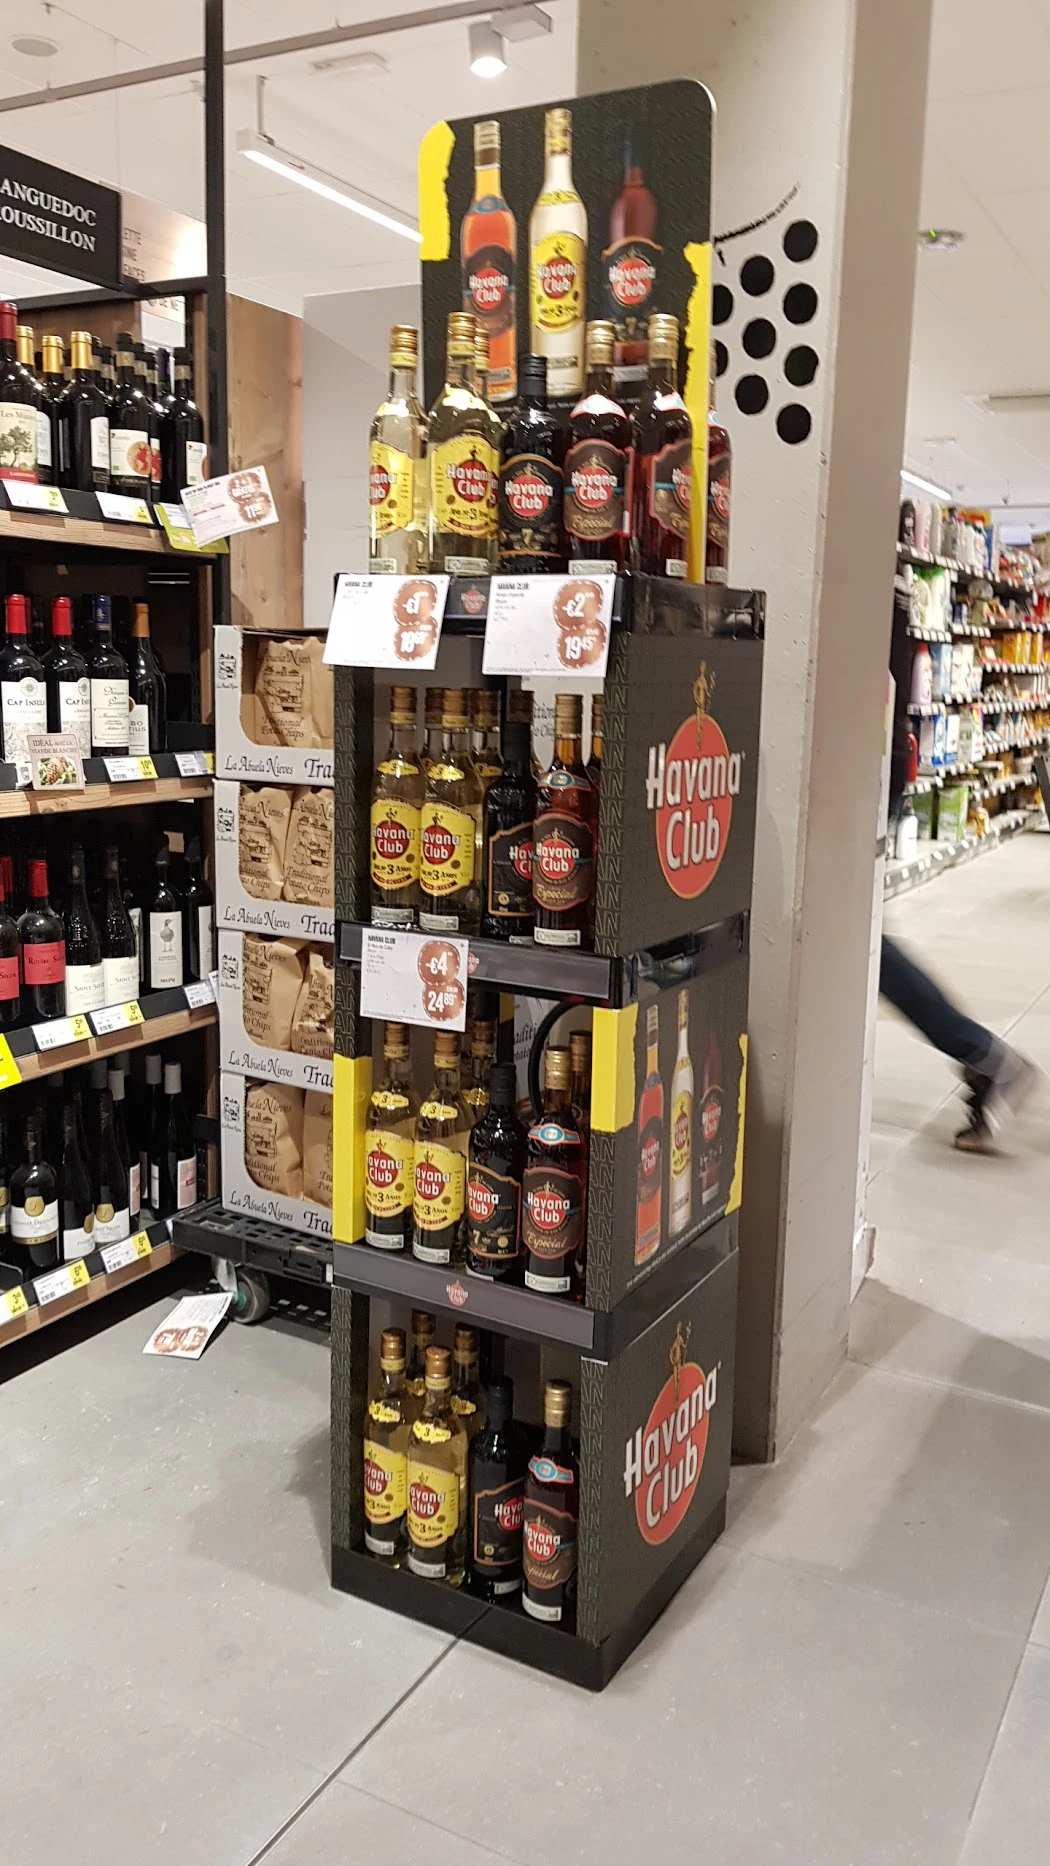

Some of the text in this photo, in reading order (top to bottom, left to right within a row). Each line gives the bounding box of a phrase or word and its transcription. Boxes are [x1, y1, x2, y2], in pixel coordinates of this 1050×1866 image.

[0, 178, 97, 227] ANGUEDOC
[0, 206, 96, 252] OUSSILLON
[537, 263, 577, 281] Havana
[609, 265, 656, 283] Havana
[469, 274, 509, 290] Havana
[544, 277, 572, 294] Club
[618, 281, 647, 297] Club
[476, 288, 502, 303] Club
[571, 471, 618, 487] Havana
[371, 484, 386, 499] lub
[457, 480, 486, 496] Club
[505, 480, 554, 497] Havana
[580, 484, 608, 500] Club
[513, 495, 544, 510] Club
[224, 755, 334, 778] La Abuela Nieves Tra
[646, 743, 742, 810] Havana
[666, 804, 720, 872] Club
[377, 839, 403, 854] Club
[424, 844, 449, 859] Club
[536, 842, 579, 859] Havana
[386, 864, 395, 875] 3
[520, 860, 531, 873] Cl
[542, 858, 569, 872] Club
[432, 870, 440, 881] 3
[223, 906, 236, 921] La
[237, 907, 262, 925] Abuela
[264, 909, 291, 931] Nieves
[228, 1050, 239, 1065] La
[241, 1053, 266, 1069] Abuela
[267, 1058, 293, 1078] Nieves
[368, 1156, 403, 1170] avana
[369, 1167, 393, 1183] Club
[415, 1167, 450, 1183] avana
[416, 1178, 439, 1196] Club
[377, 1192, 384, 1202] 3
[468, 1187, 499, 1205] avana
[527, 1191, 570, 1210] Havana
[230, 1191, 241, 1206] La
[243, 1195, 267, 1214] Abuela
[268, 1202, 294, 1222] Nieves
[424, 1205, 431, 1215] 3
[469, 1198, 488, 1215] Club
[534, 1208, 560, 1223] Club
[472, 1229, 480, 1245] 7
[526, 1231, 567, 1249] Especial
[374, 1406, 381, 1415] 3
[424, 1427, 430, 1437] 3
[624, 1366, 718, 1498] Havana
[365, 1464, 392, 1481] vana
[645, 1437, 699, 1529] Club
[410, 1486, 445, 1503] avana
[412, 1497, 434, 1515] Club
[494, 1501, 523, 1517] Hava
[528, 1538, 551, 1557] Club
[528, 1565, 559, 1580] pecial
